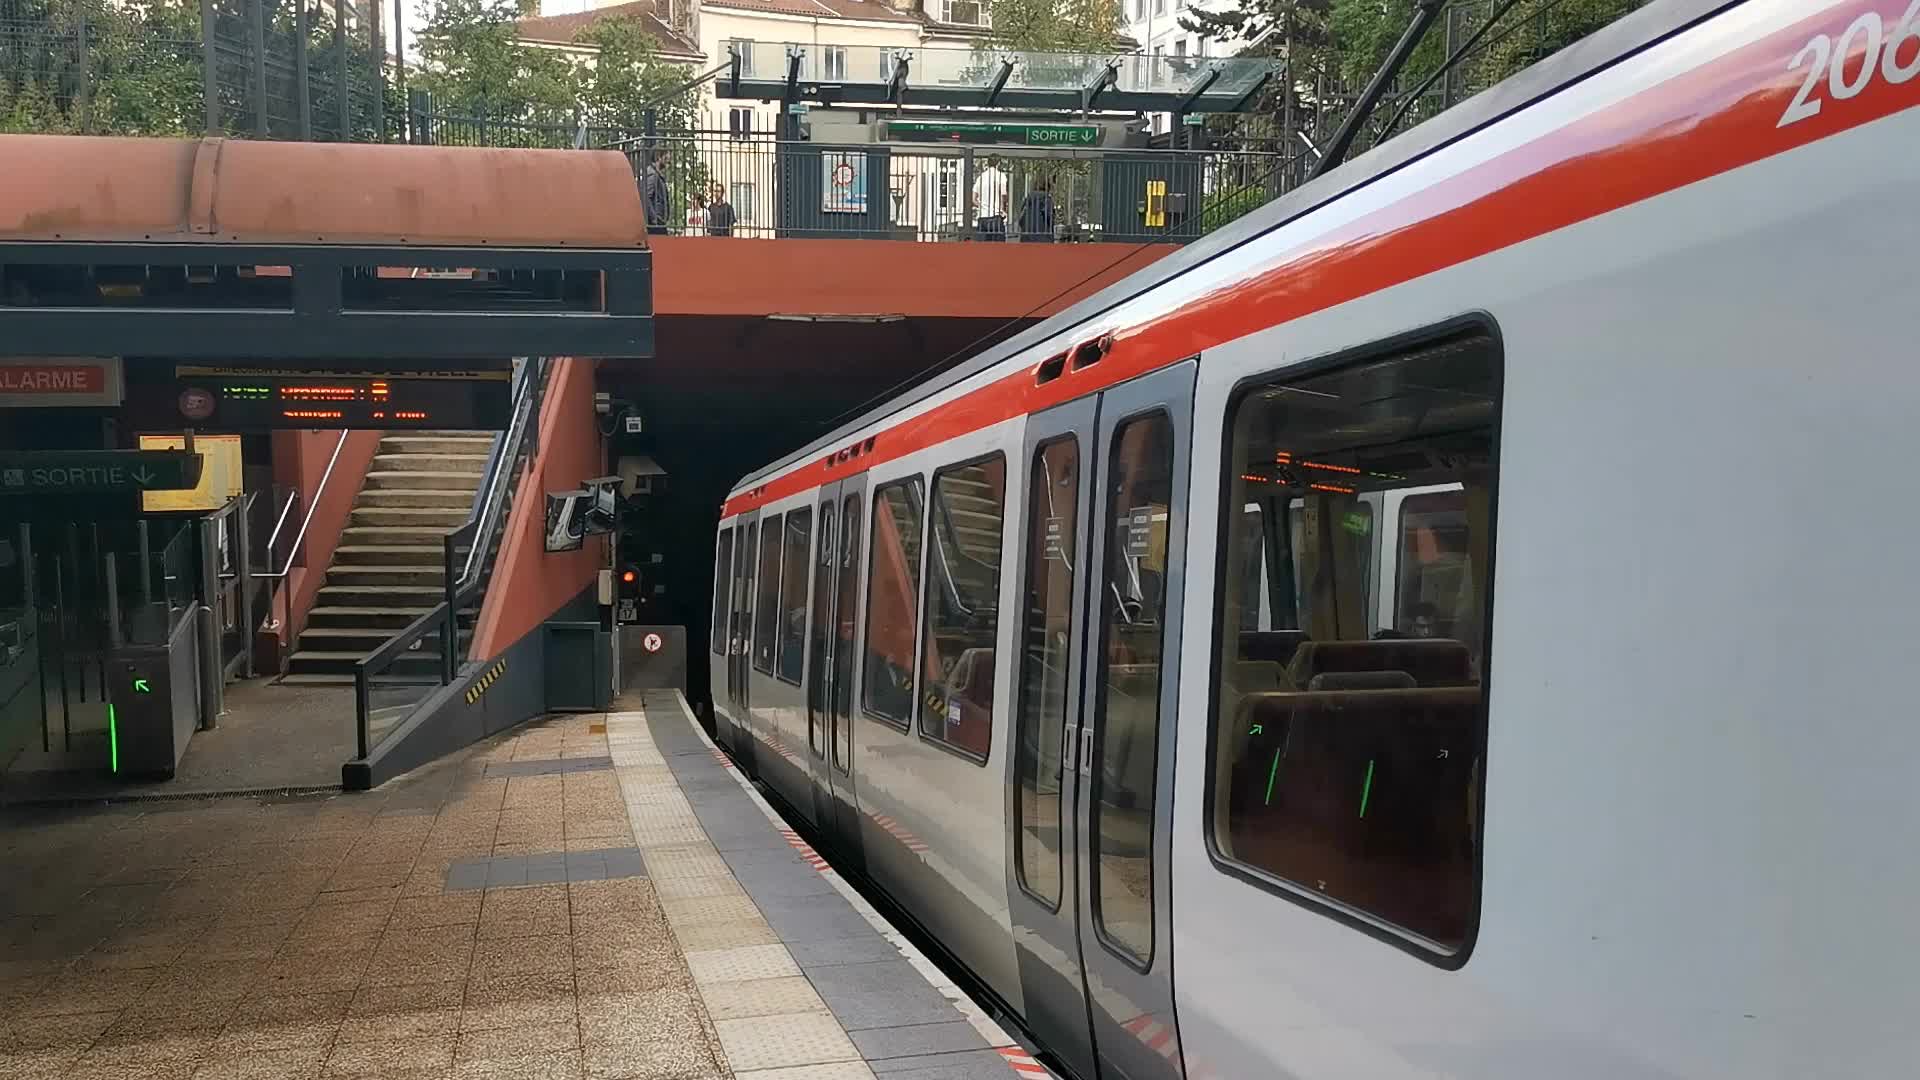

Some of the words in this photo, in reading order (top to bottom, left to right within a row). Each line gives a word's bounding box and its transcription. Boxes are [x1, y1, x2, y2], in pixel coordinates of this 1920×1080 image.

[1775, 0, 1920, 129] 206
[1031, 129, 1078, 142] SORTIE
[0, 371, 88, 389] LARME
[31, 467, 126, 486] SORTIE
